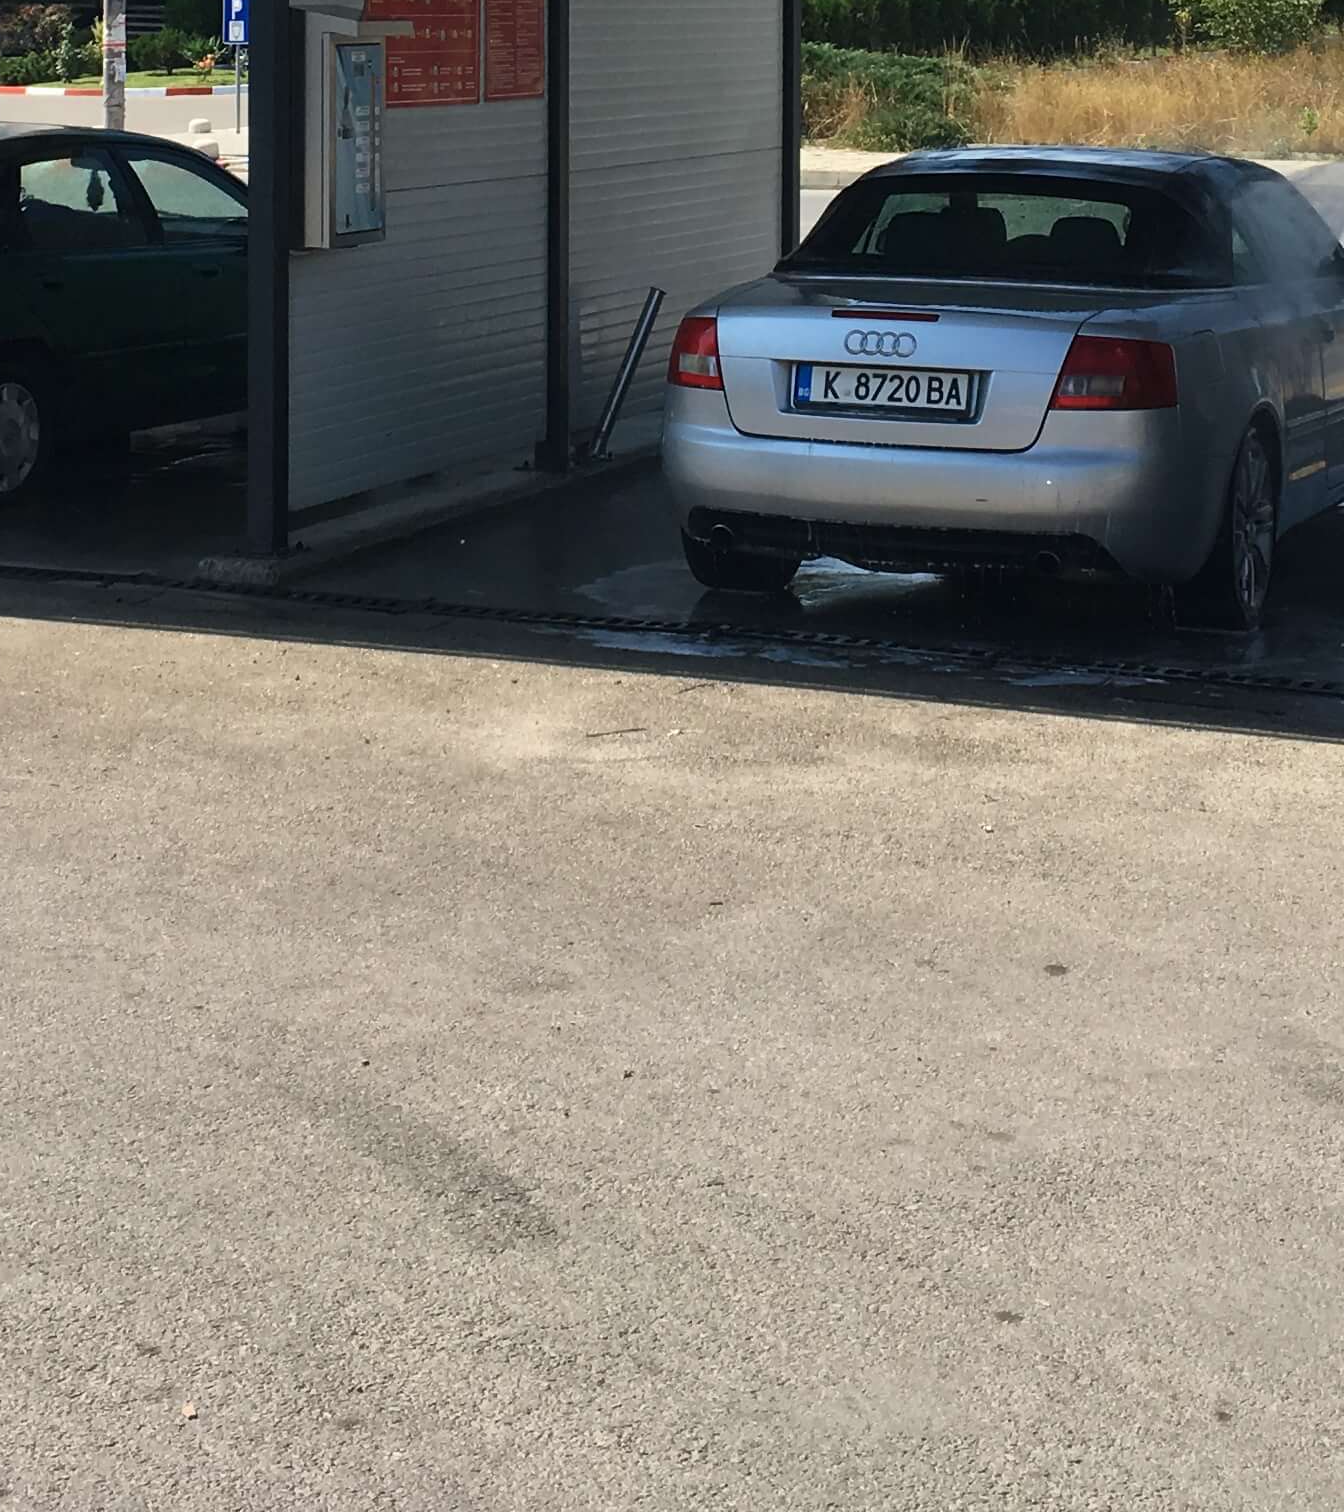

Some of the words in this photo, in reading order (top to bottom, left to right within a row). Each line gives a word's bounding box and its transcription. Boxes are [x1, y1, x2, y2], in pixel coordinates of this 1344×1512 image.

[823, 370, 842, 400] K
[854, 372, 921, 404] 8720
[926, 376, 962, 407] BA
